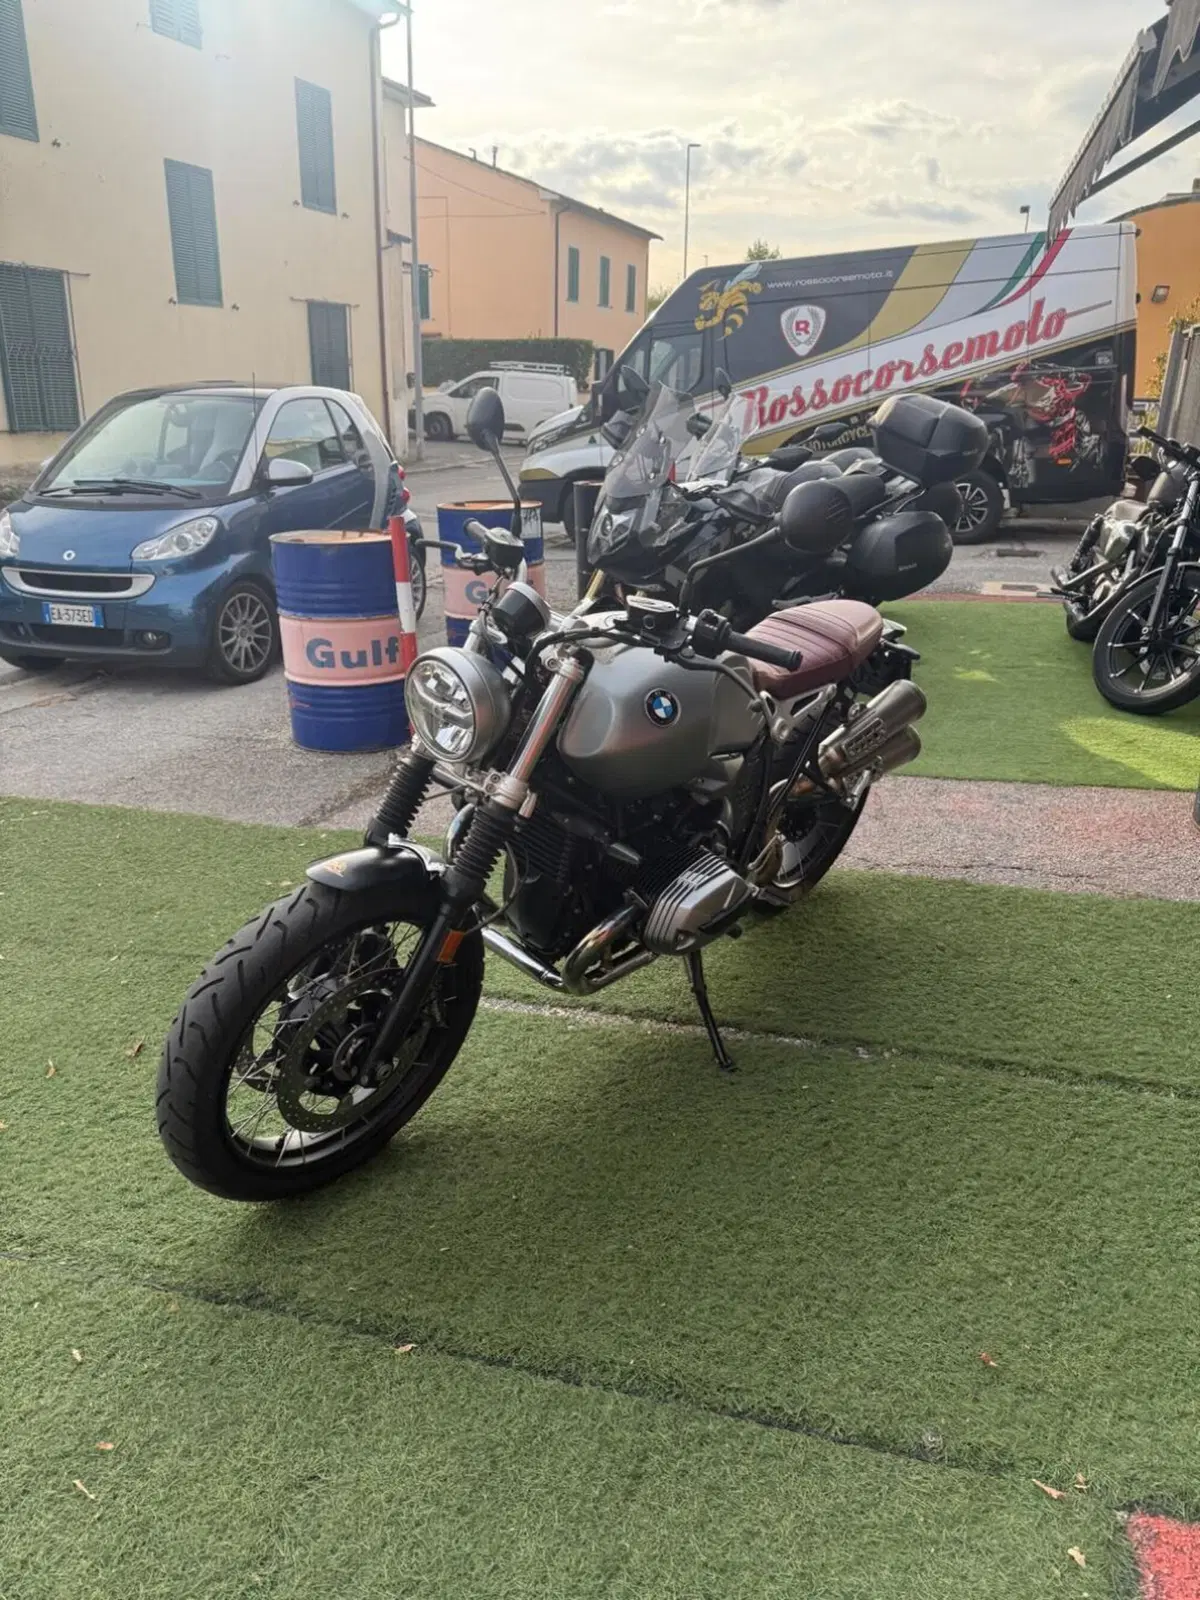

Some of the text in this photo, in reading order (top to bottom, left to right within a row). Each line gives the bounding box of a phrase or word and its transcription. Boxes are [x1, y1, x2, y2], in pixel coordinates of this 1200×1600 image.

[795, 320, 810, 335] R
[739, 296, 1068, 436] Rossocorsemoto
[306, 635, 400, 669] Gulf
